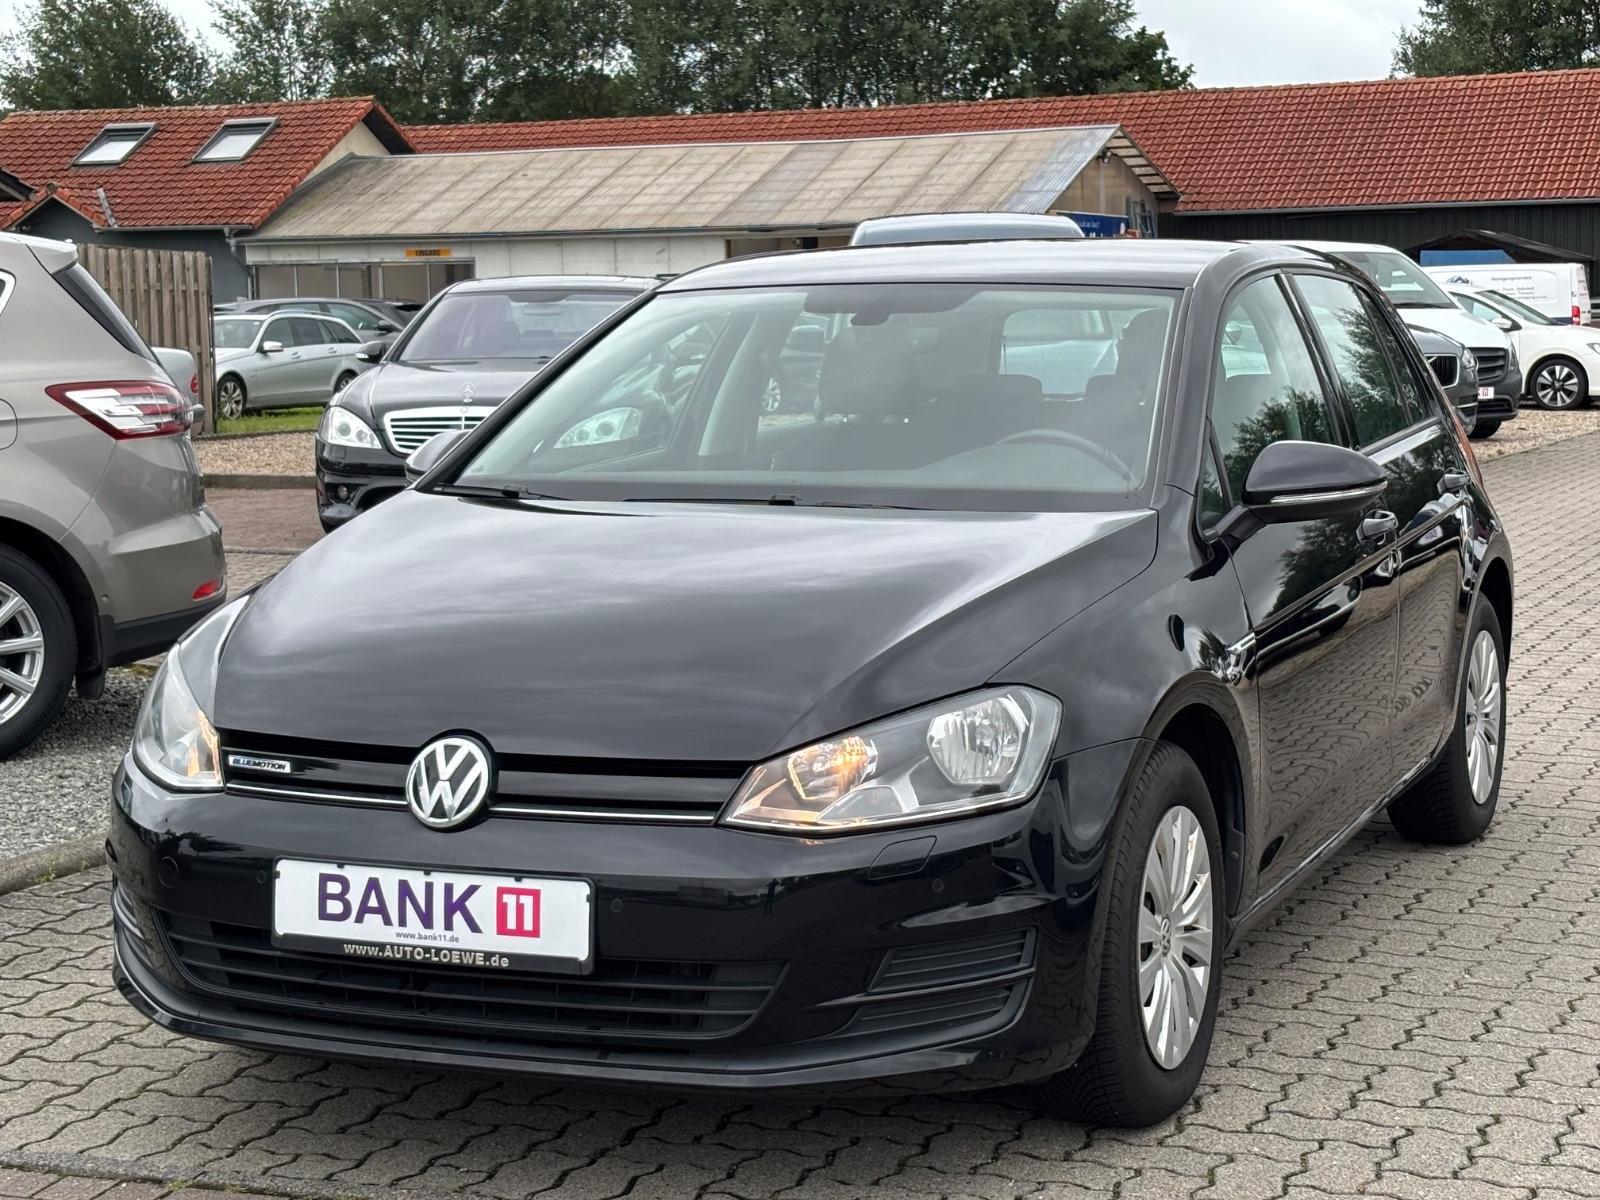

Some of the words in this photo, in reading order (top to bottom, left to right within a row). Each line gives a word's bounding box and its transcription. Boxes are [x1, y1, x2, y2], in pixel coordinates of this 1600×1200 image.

[232, 758, 287, 770] BLUEMOTION
[318, 872, 483, 934] BANK
[501, 892, 534, 932] 11
[395, 930, 460, 944] www.bank11.de
[343, 943, 510, 968] www.AUTO-LOEWE.de
